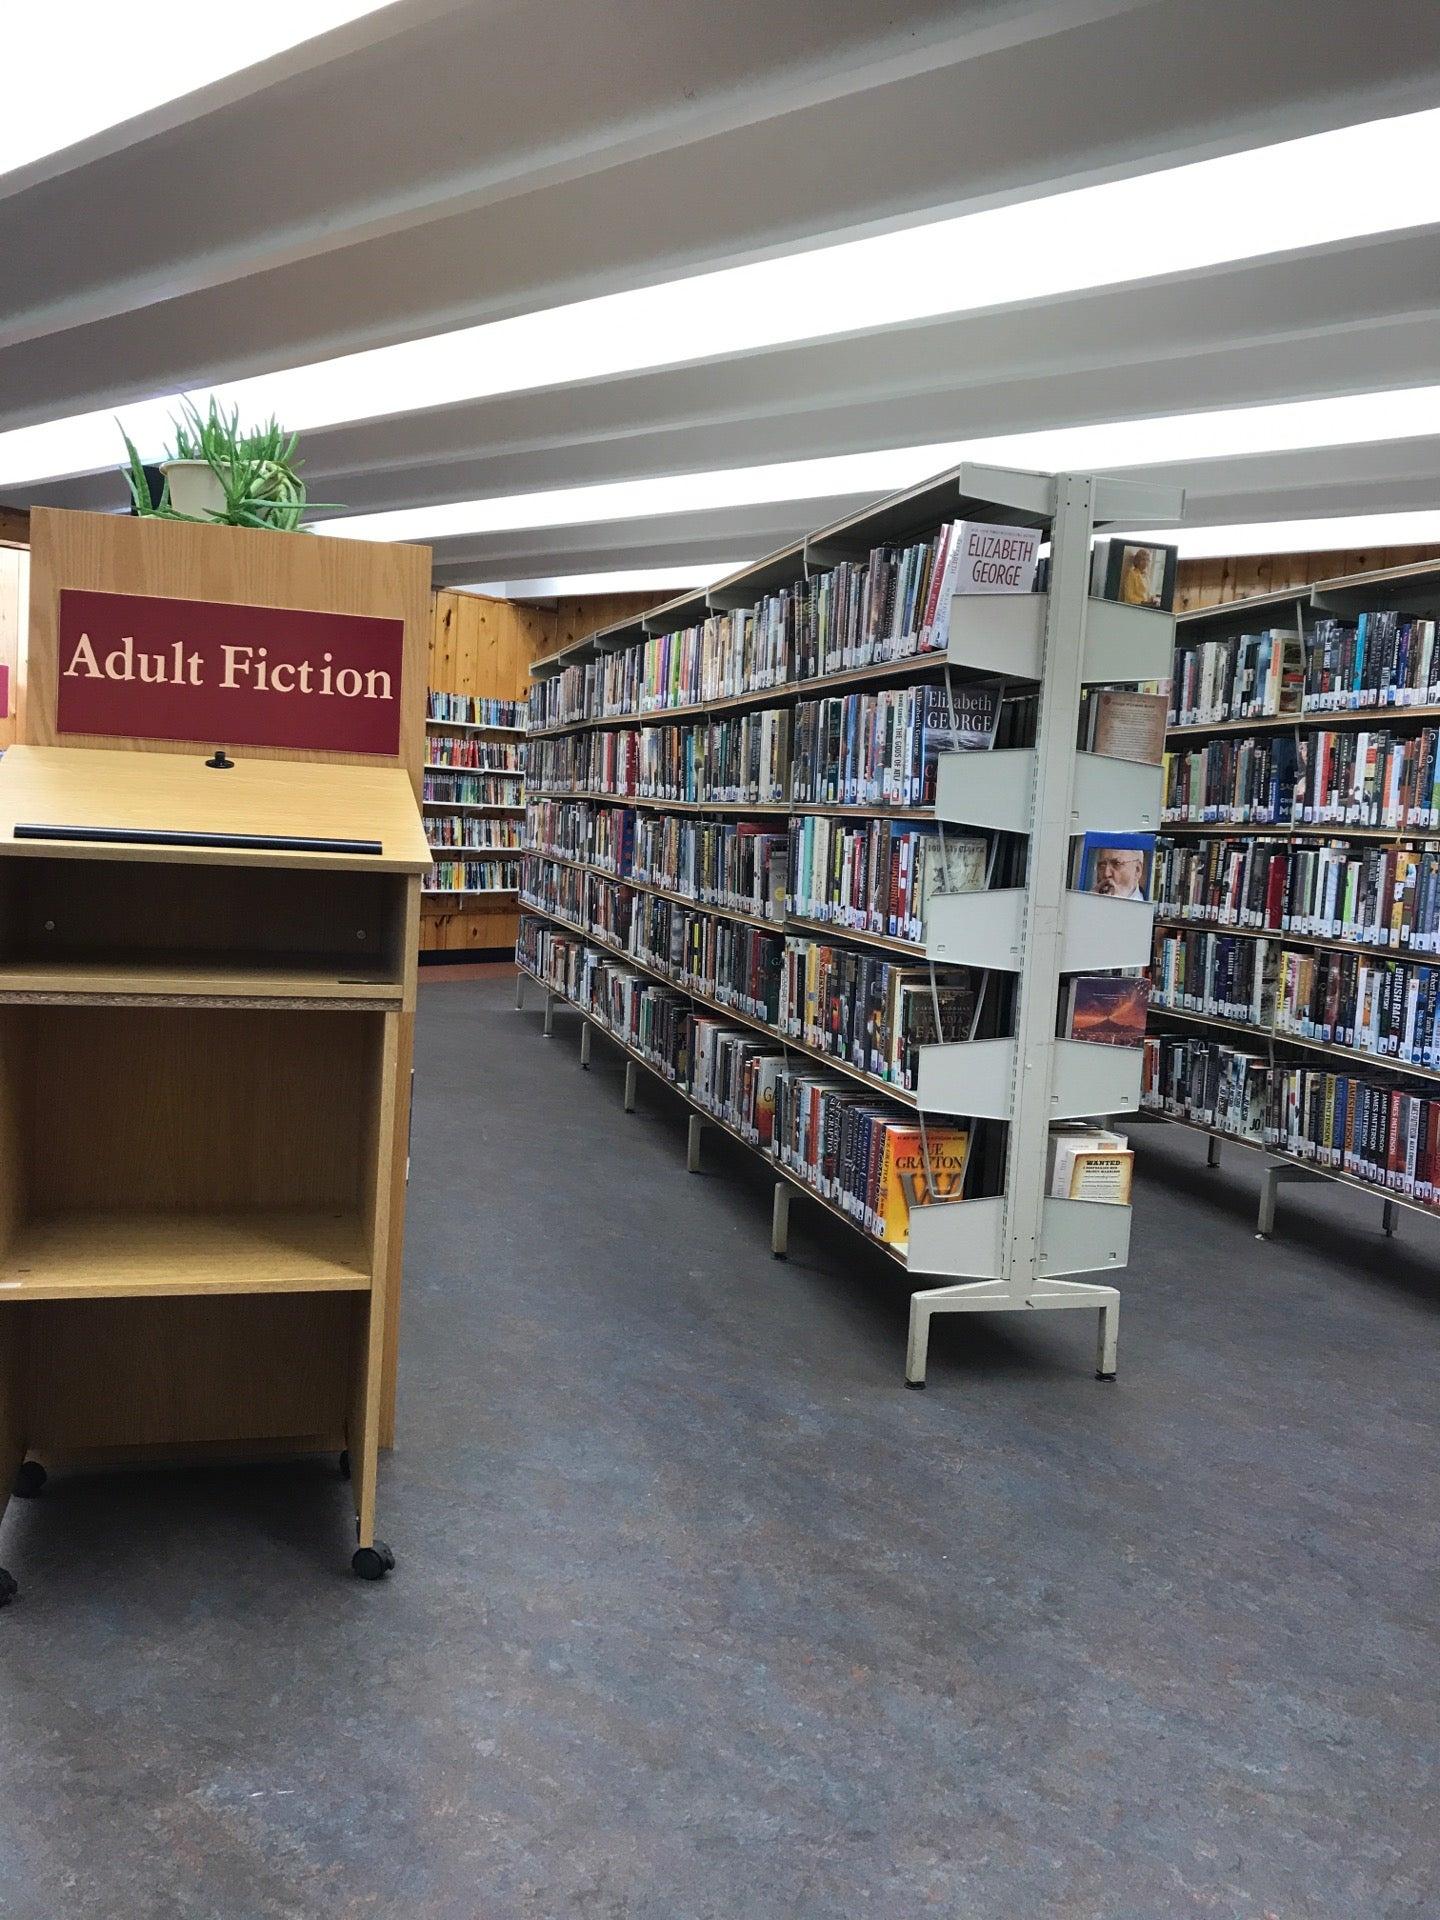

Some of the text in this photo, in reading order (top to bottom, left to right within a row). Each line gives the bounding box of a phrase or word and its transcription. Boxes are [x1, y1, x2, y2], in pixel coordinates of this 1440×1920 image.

[968, 534, 1033, 562] ELIZABETH
[972, 560, 1022, 586] GEORGE
[63, 632, 394, 701] Adult Fiction
[915, 691, 923, 727] Elizabeth
[1391, 968, 1404, 1029] BRUSH BACK
[1324, 1077, 1334, 1143] JAMES PATTERSON
[1362, 1110, 1370, 1147] PATTERSON
[1390, 1096, 1400, 1155] JAMES PATTERSON
[918, 1143, 943, 1155] SUE
[1370, 1113, 1378, 1150] PATTERSON
